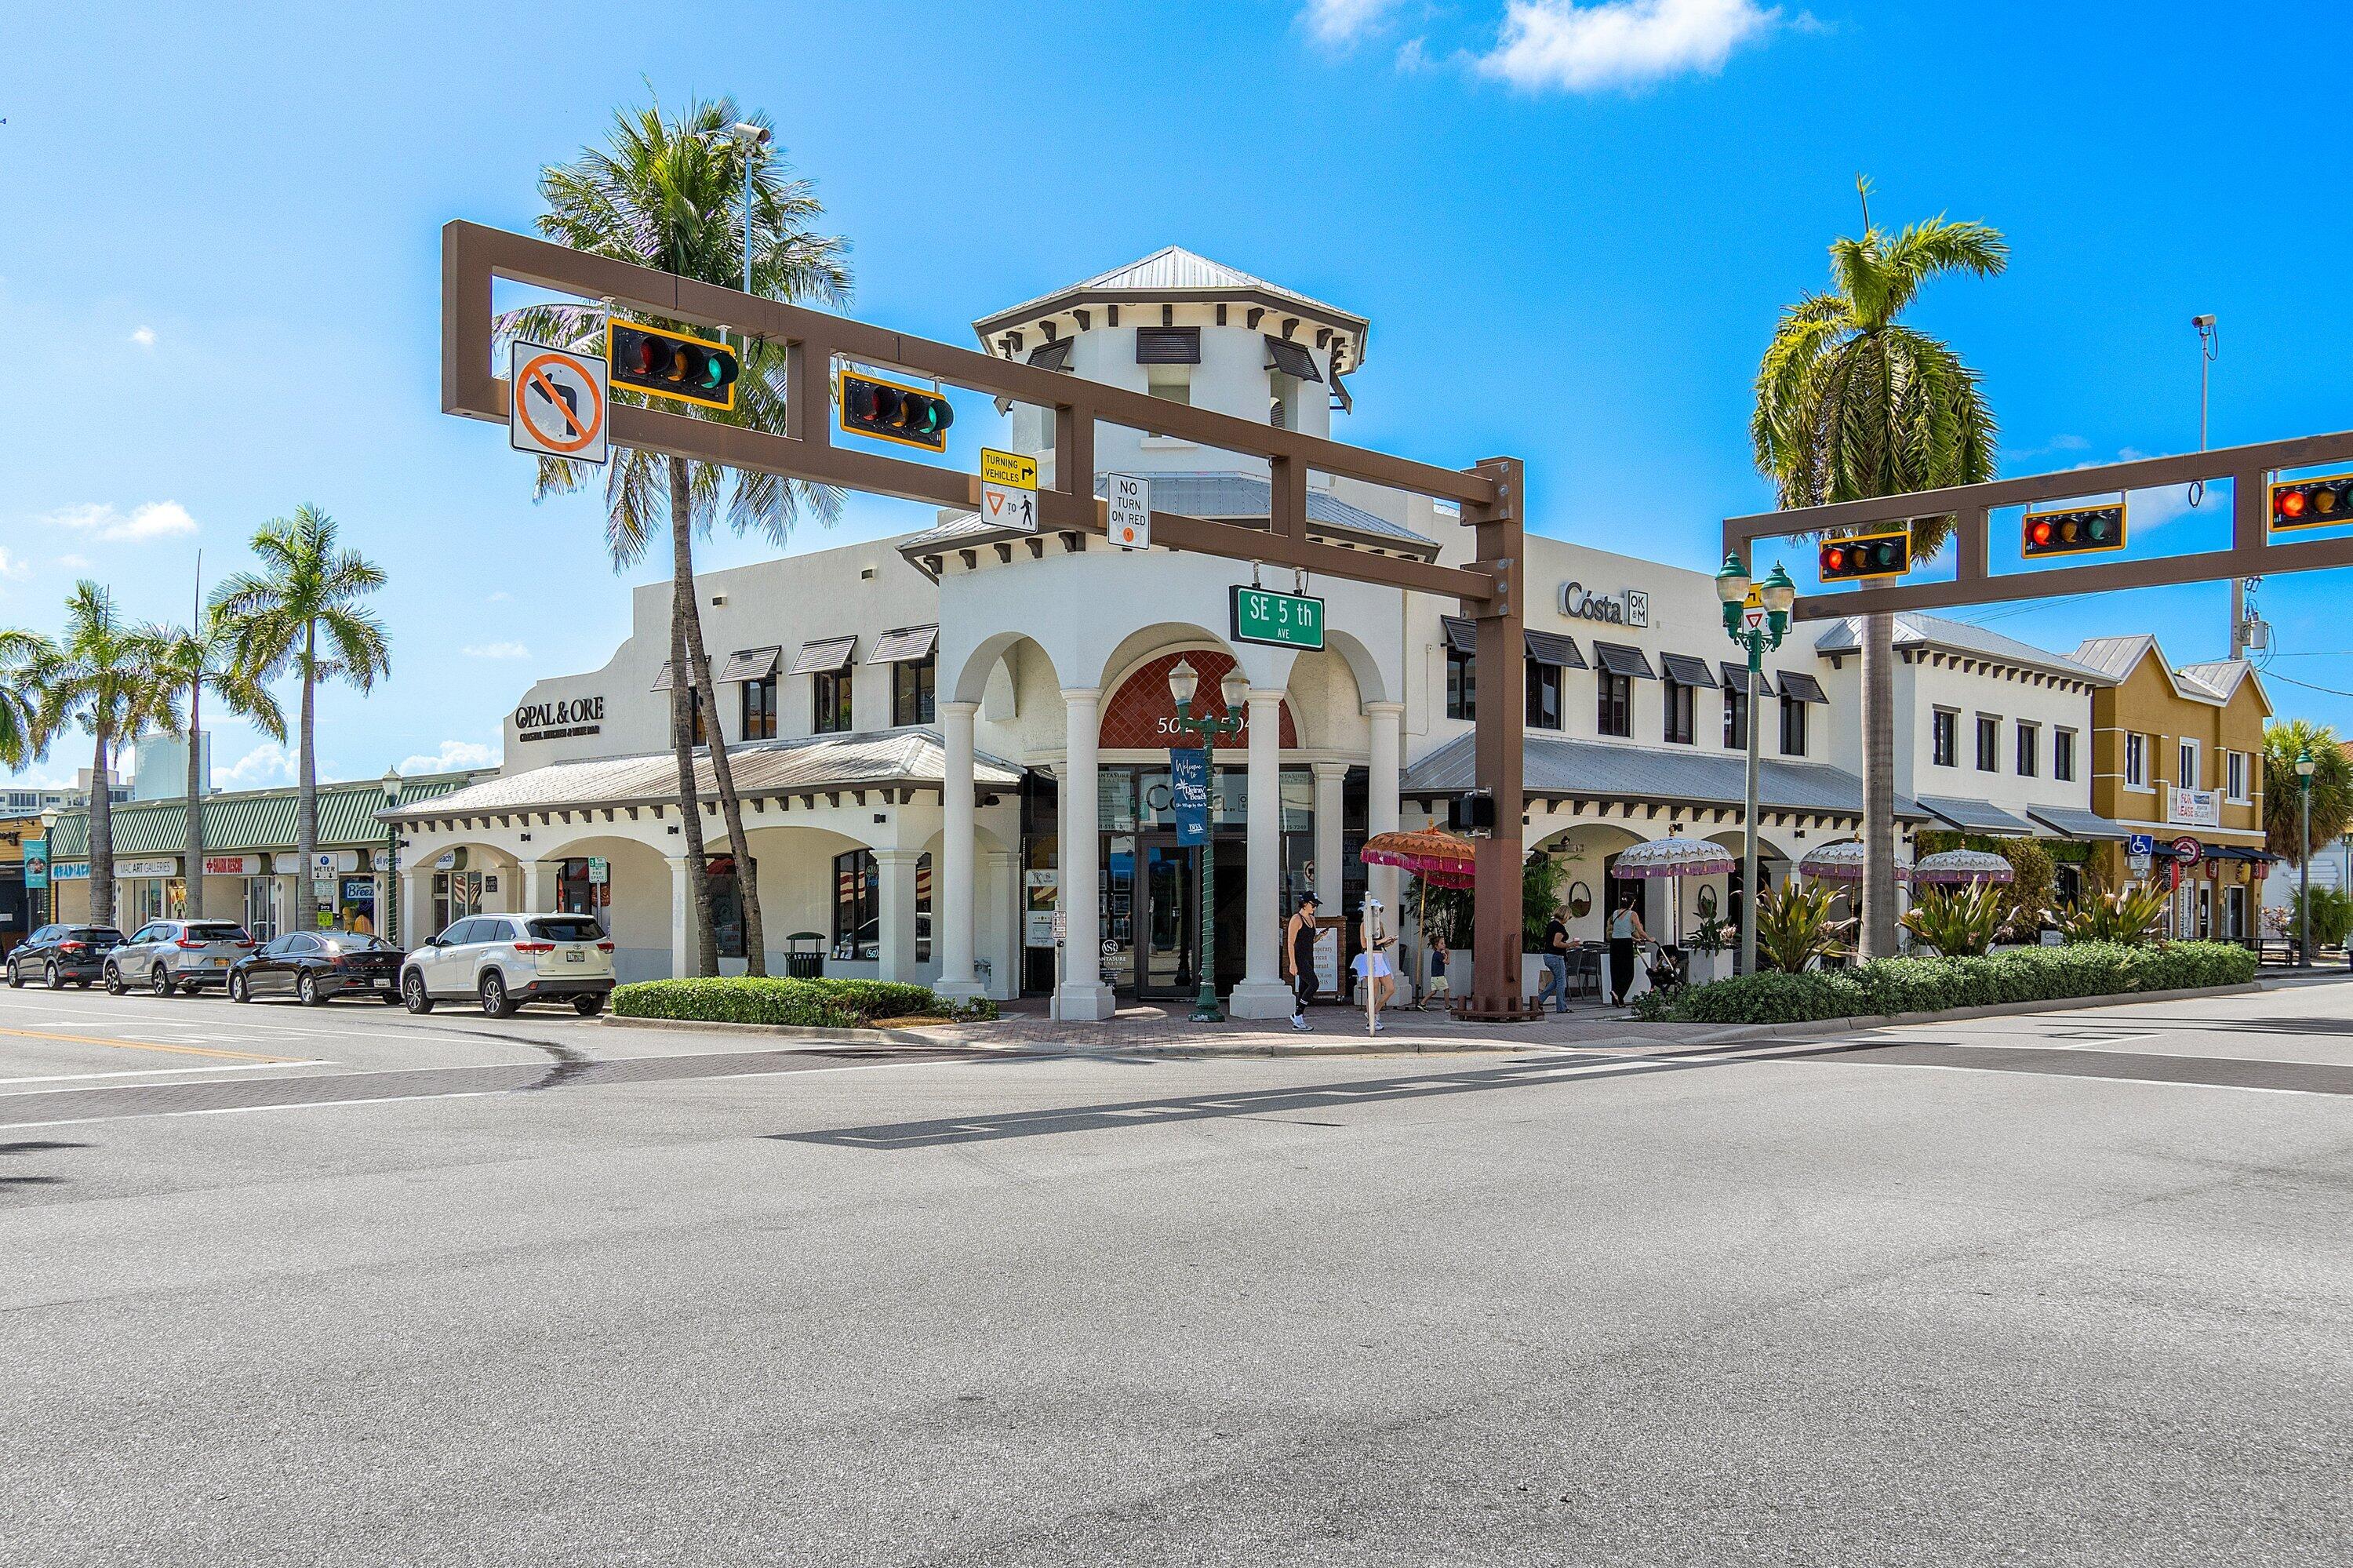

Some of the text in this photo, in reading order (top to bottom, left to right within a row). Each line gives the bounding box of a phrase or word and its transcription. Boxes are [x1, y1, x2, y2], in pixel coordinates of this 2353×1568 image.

[986, 454, 1018, 469] TURNING
[985, 468, 1020, 482] VEHICLES
[1120, 480, 1137, 495] NO
[1008, 503, 1016, 512] TO
[1118, 497, 1140, 511] TURN
[1112, 511, 1146, 526] ON RED
[1565, 582, 1623, 624] Cósta
[1631, 595, 1646, 609] OK
[1250, 595, 1312, 627] SE 5 th
[1638, 609, 1646, 622] M
[1277, 628, 1290, 639] AVE
[515, 696, 604, 729] OPAL & ORE
[587, 725, 600, 734] BAR
[1176, 759, 1202, 776] Welcome
[1185, 786, 1206, 795] Delray
[2180, 793, 2192, 805] FOR
[2177, 805, 2194, 817] LEASE
[437, 853, 453, 862] each!
[120, 861, 170, 874] MAC ART GALLERIES
[348, 884, 374, 897] Breez
